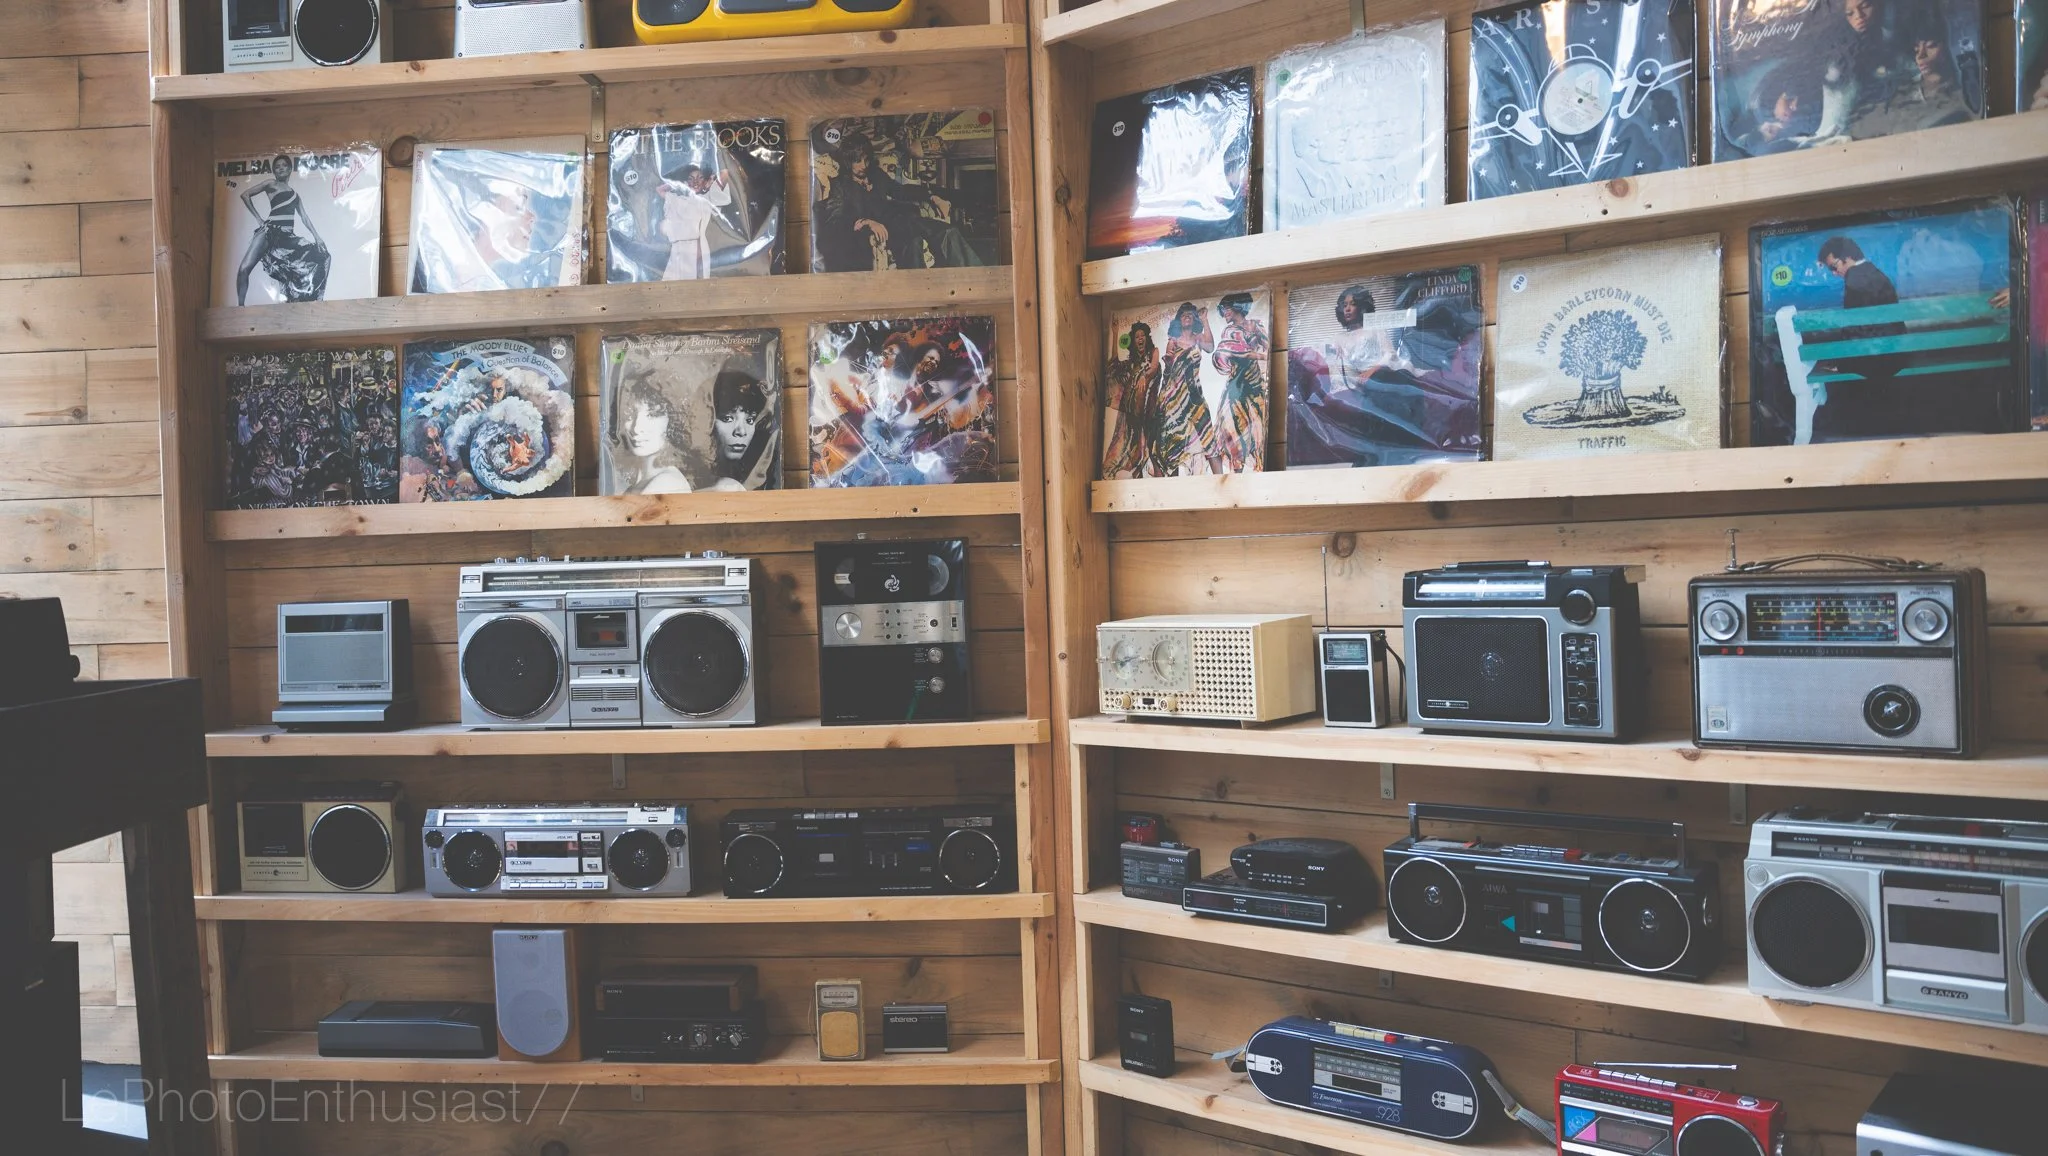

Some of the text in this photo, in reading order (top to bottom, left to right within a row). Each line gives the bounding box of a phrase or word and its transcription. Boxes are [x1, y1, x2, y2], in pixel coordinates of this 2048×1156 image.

[693, 124, 782, 150] BROOKS
[826, 131, 840, 140] $10
[217, 159, 272, 177] MELBA
[1290, 183, 1413, 219] MASTERPIEC
[1426, 274, 1458, 287] LINDA
[1774, 270, 1788, 281] $10
[1512, 275, 1525, 291] $10
[1417, 284, 1468, 298] CLIFFORD
[1535, 286, 1674, 355] JOHN BARLEYCORN MUST DIE
[451, 341, 529, 360] THE MOODY BLUES
[552, 348, 565, 356] $10
[486, 356, 520, 368] Question
[531, 355, 560, 379] Balance
[1577, 435, 1627, 449] TRAFFIC
[1167, 856, 1184, 864] SONY
[1481, 883, 1508, 895] AIWA
[1929, 988, 1968, 999] SANYO
[889, 1015, 918, 1023] stereo
[1377, 1106, 1401, 1123] 928
